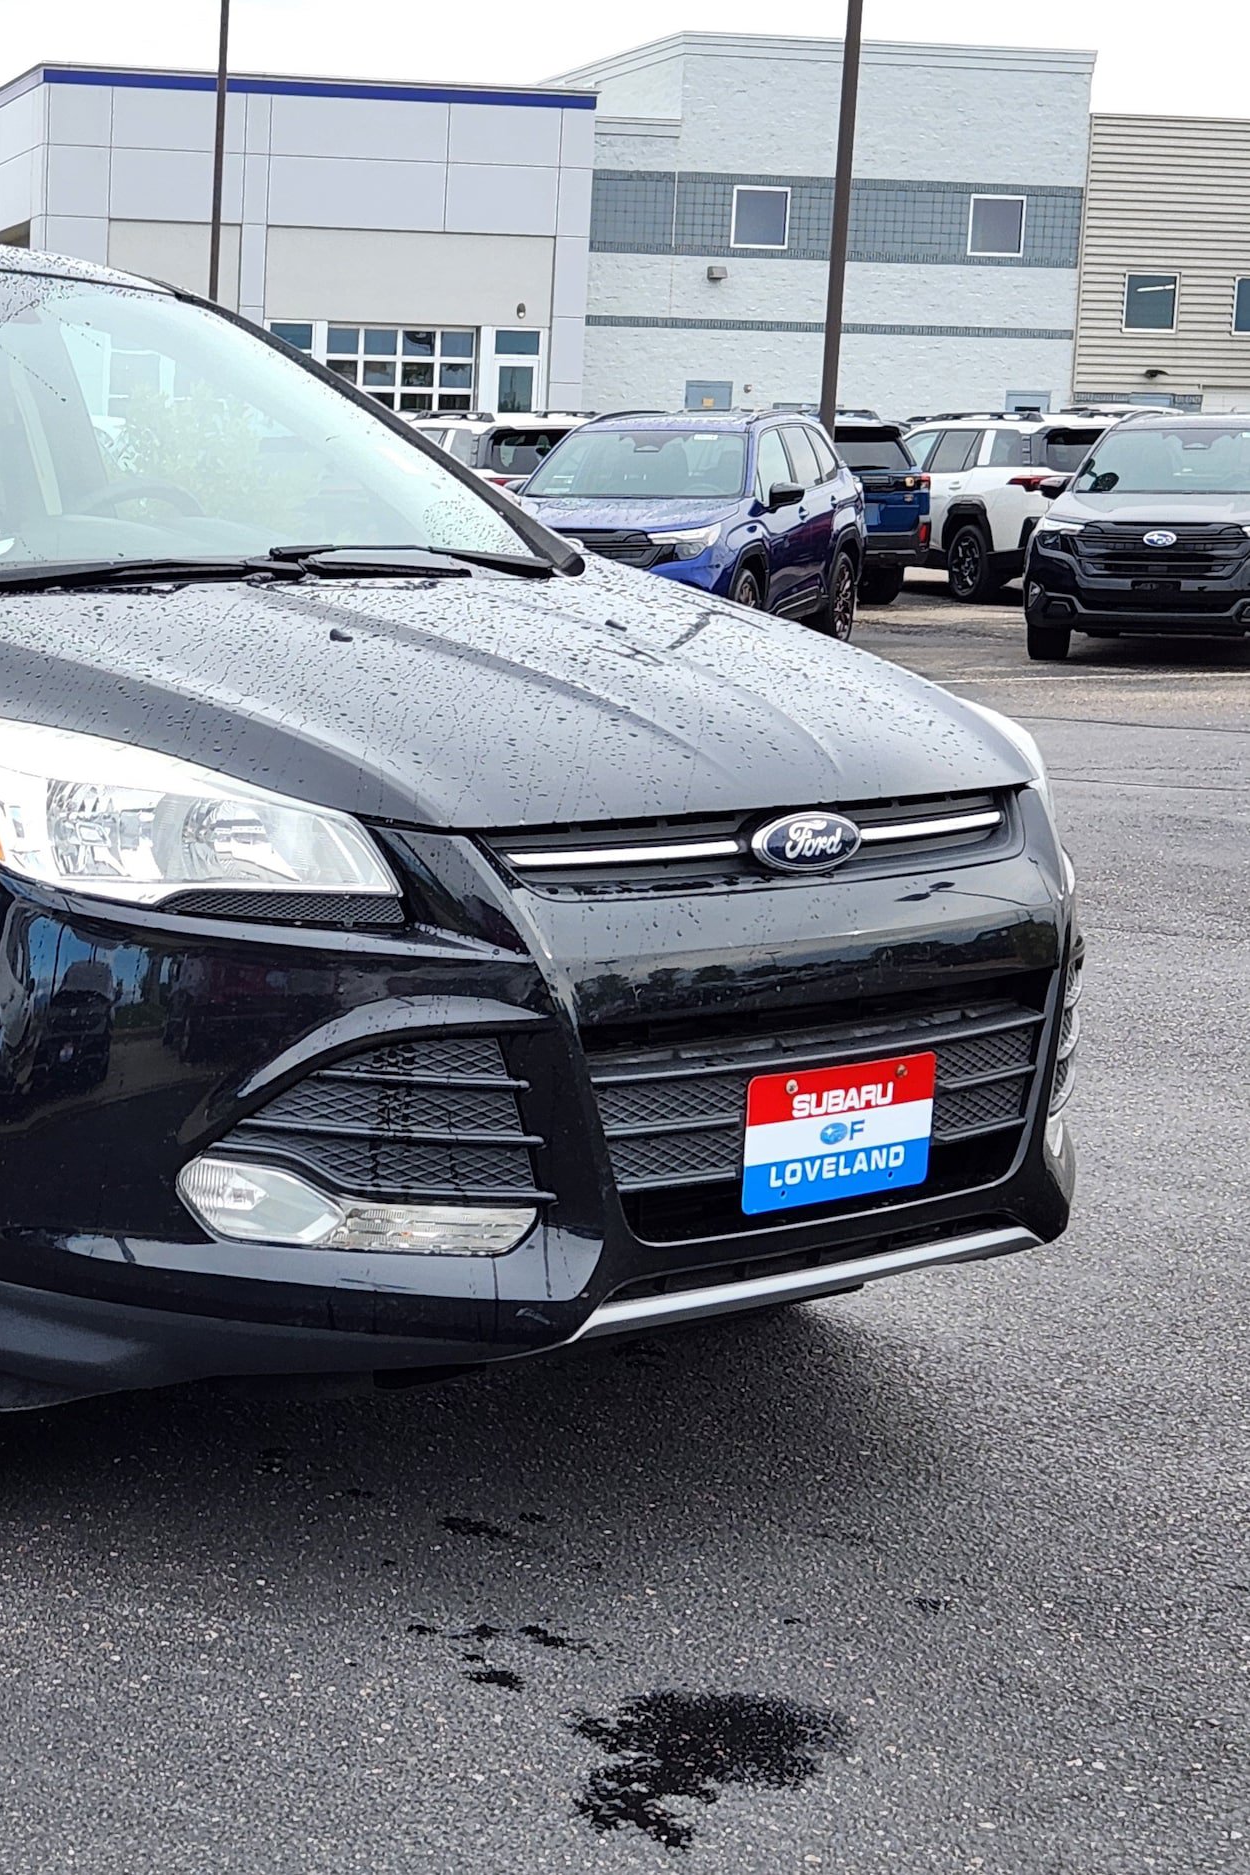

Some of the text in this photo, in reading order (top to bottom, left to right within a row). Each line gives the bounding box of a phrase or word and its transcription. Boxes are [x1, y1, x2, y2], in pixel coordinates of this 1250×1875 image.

[785, 819, 843, 859] Ford
[792, 1081, 894, 1118] SUBARU
[769, 1145, 905, 1188] LOVELAND
